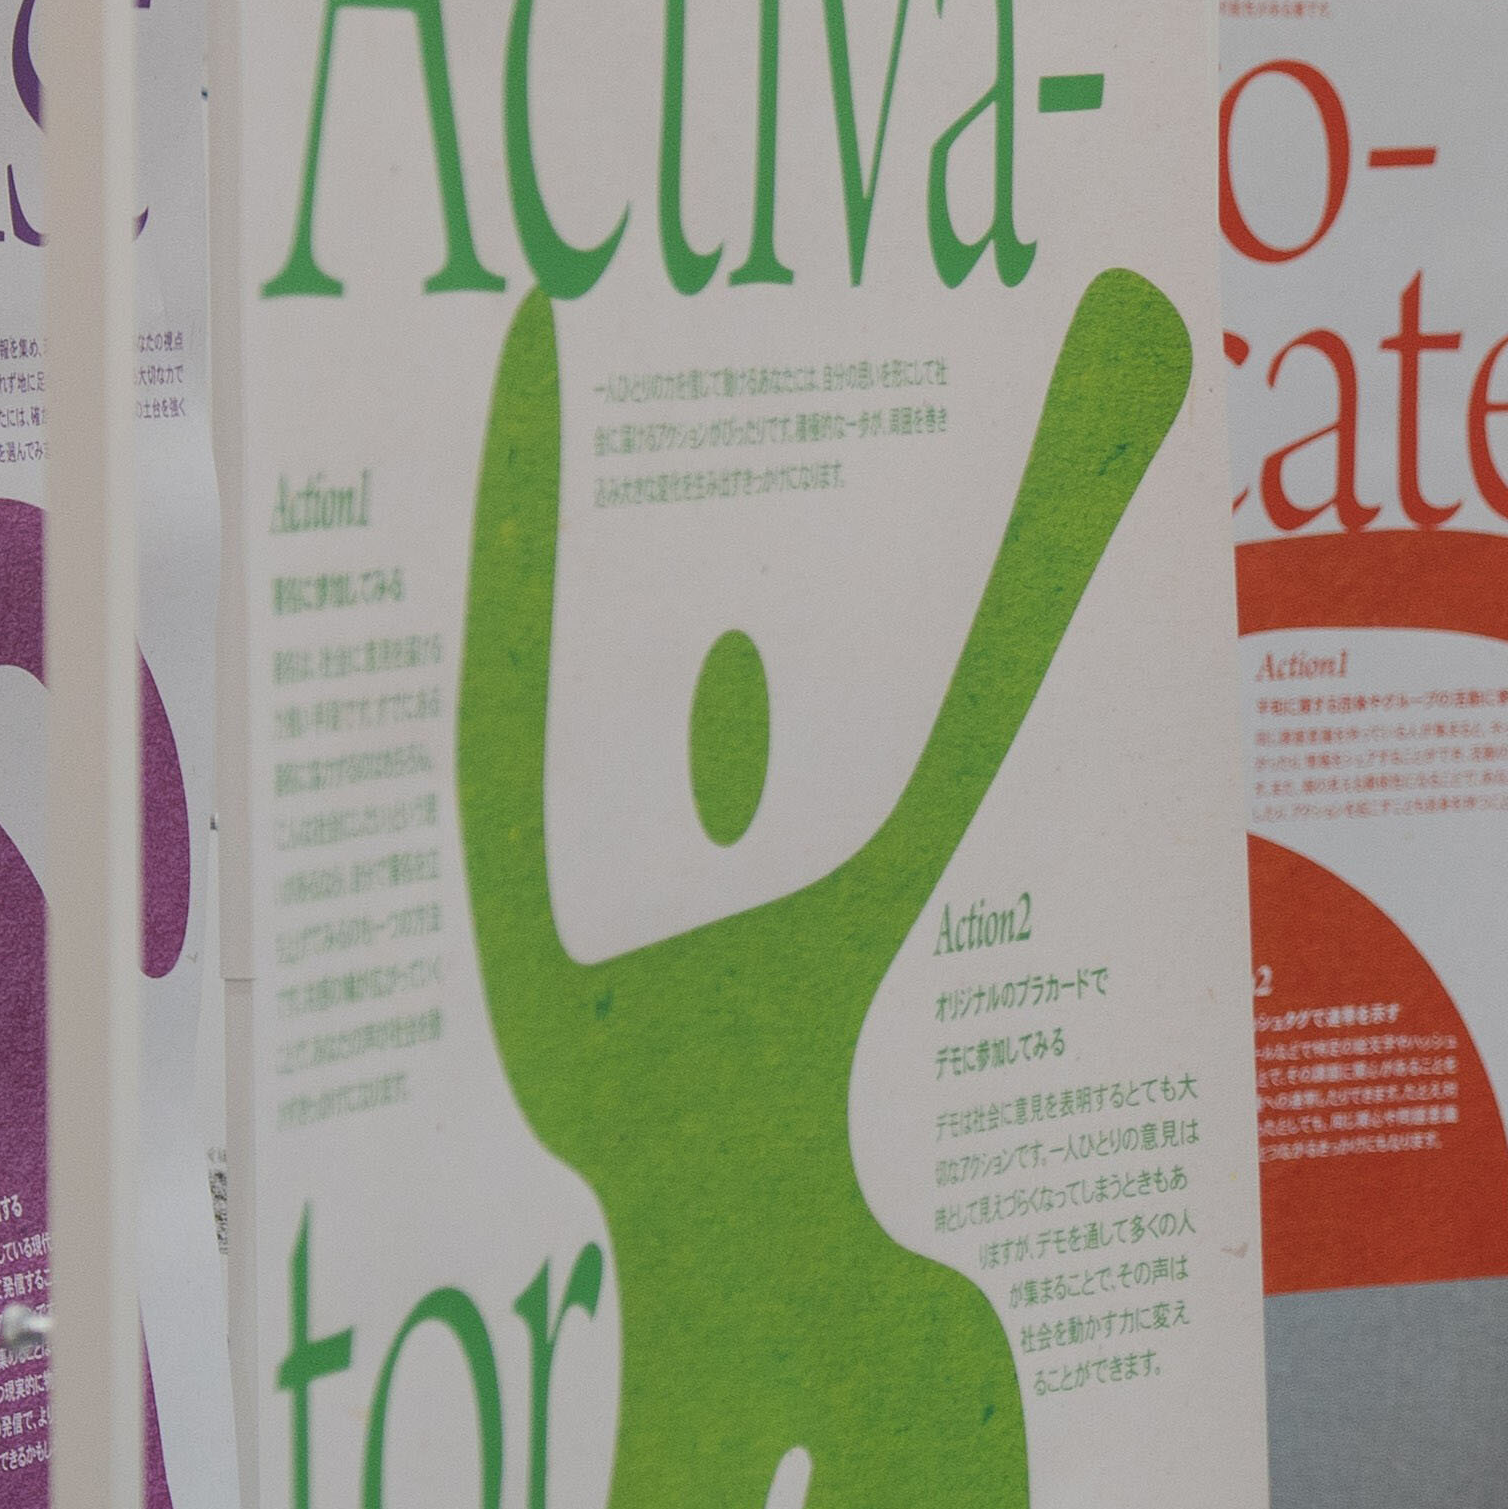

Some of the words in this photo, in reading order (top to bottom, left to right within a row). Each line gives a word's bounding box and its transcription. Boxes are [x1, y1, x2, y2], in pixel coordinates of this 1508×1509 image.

[269, 468, 373, 535] Action1
[1255, 647, 1347, 682] Action1
[933, 892, 1033, 956] Action2
[935, 966, 1109, 1023] オリジナルのプラカードで
[935, 1026, 1067, 1081] デモに参加してみる
[935, 1072, 1198, 1142] デモは社会に意見を表明するとても大
[935, 1119, 1201, 1189] 切なアクションです。一人ひとりの意見は
[934, 1164, 1188, 1234] 時として見えづらくなってしまうときもあ
[978, 1208, 1196, 1270] りますが、デモを通して多くの人
[1008, 1255, 1189, 1310] が集まることで、その声は
[1020, 1300, 1191, 1354] 社会を動かす力に変え
[1034, 1349, 1162, 1397] ることができます。
